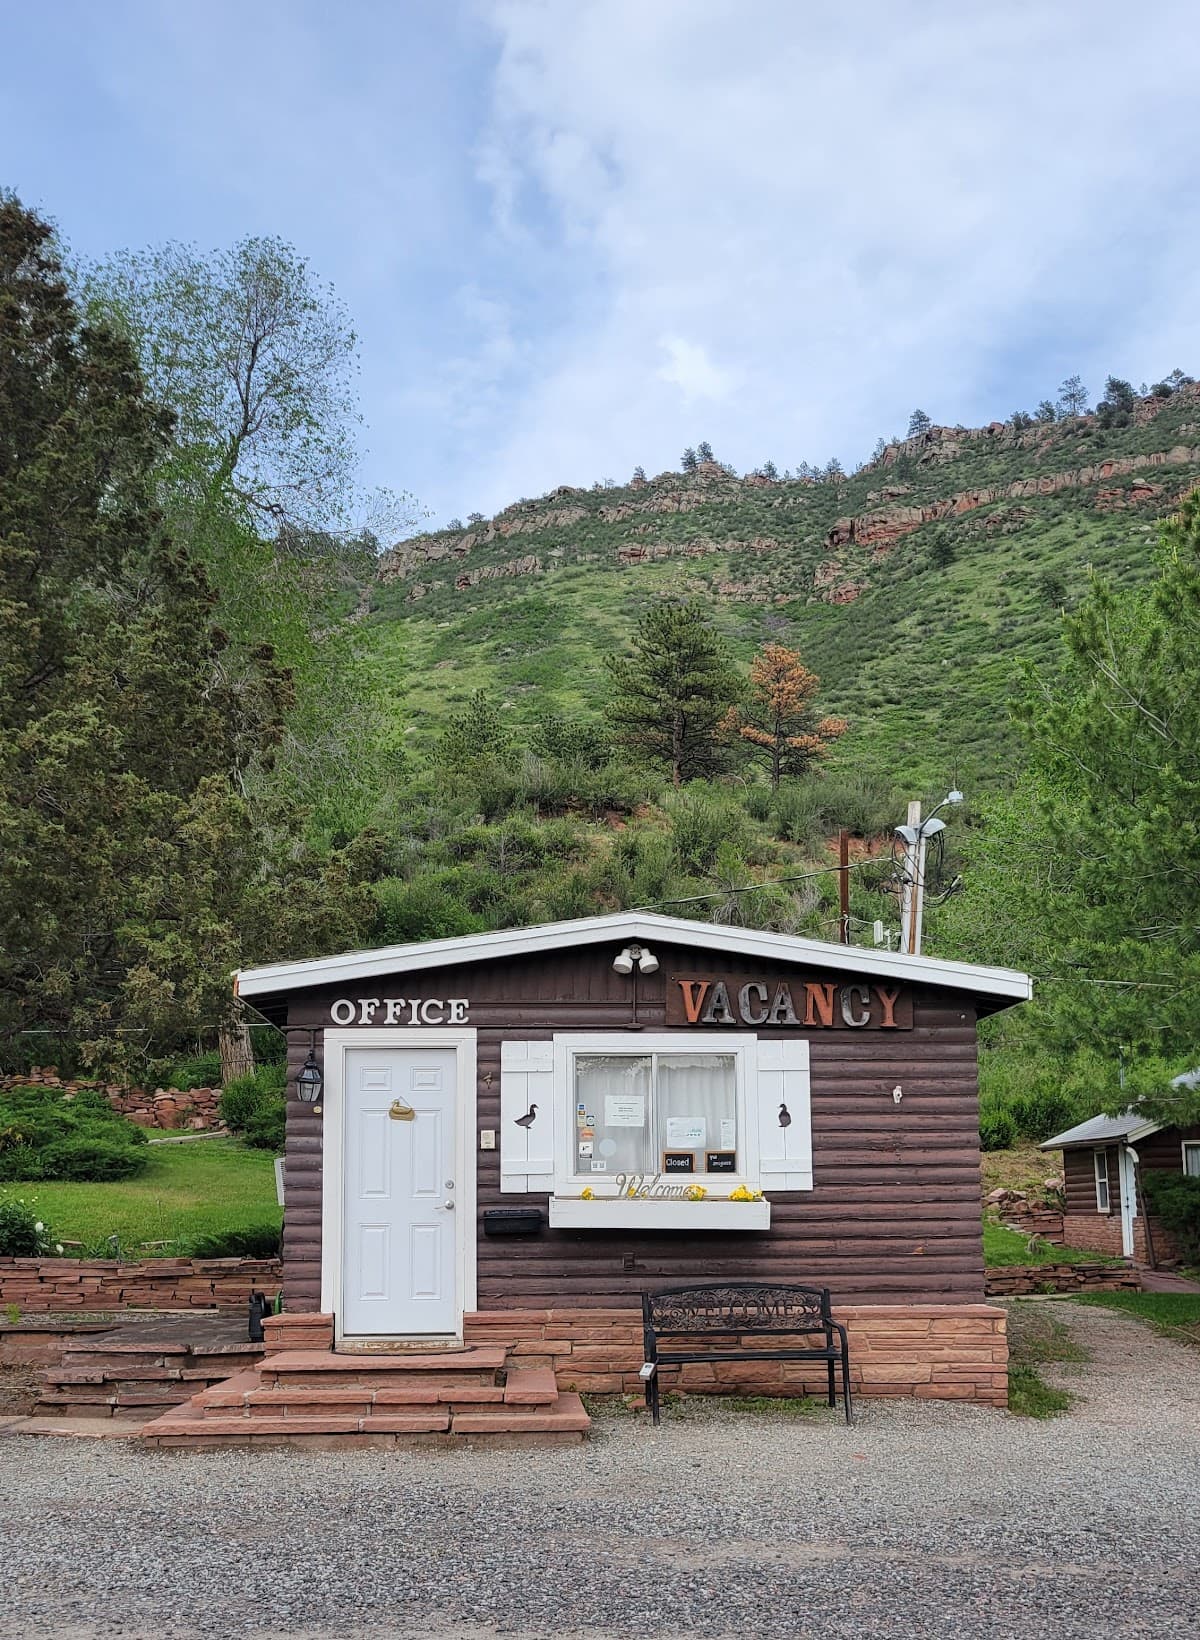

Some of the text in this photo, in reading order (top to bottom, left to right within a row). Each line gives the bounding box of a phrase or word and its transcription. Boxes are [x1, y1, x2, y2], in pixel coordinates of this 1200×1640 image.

[330, 998, 470, 1025] OFFICE
[678, 980, 901, 1027] VACANCY
[665, 1157, 690, 1167] Closed
